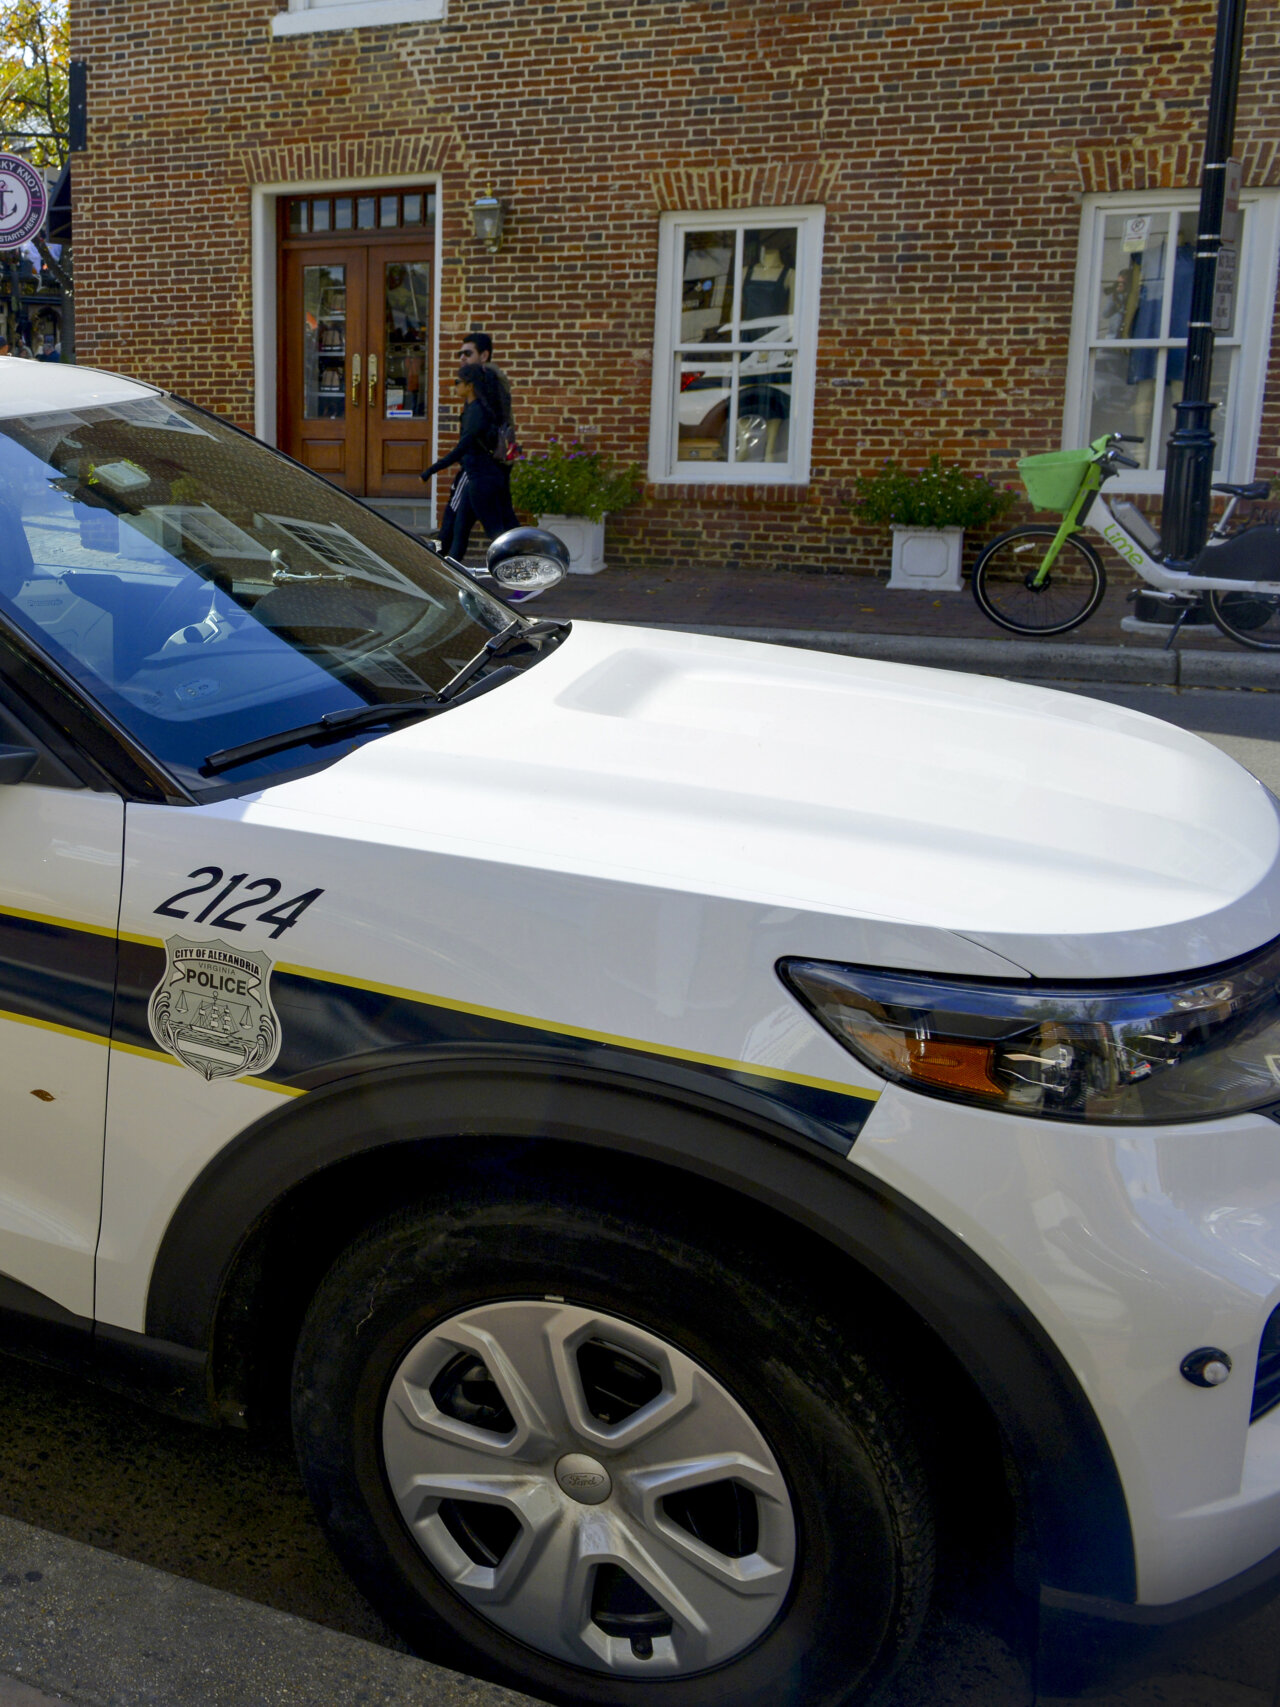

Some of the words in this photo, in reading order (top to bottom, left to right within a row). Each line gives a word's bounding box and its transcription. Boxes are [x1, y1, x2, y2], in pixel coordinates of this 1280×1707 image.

[16, 166, 40, 193] KNOT
[0, 229, 26, 243] STARTS
[23, 212, 39, 232] HERE
[1103, 523, 1144, 566] Lime
[152, 866, 326, 940] 2124
[175, 948, 194, 959] CITY
[195, 948, 207, 959] OF
[208, 950, 260, 976] ALEXANDRIA
[198, 962, 237, 976] VIRGINIA
[186, 968, 247, 997] POLICE
